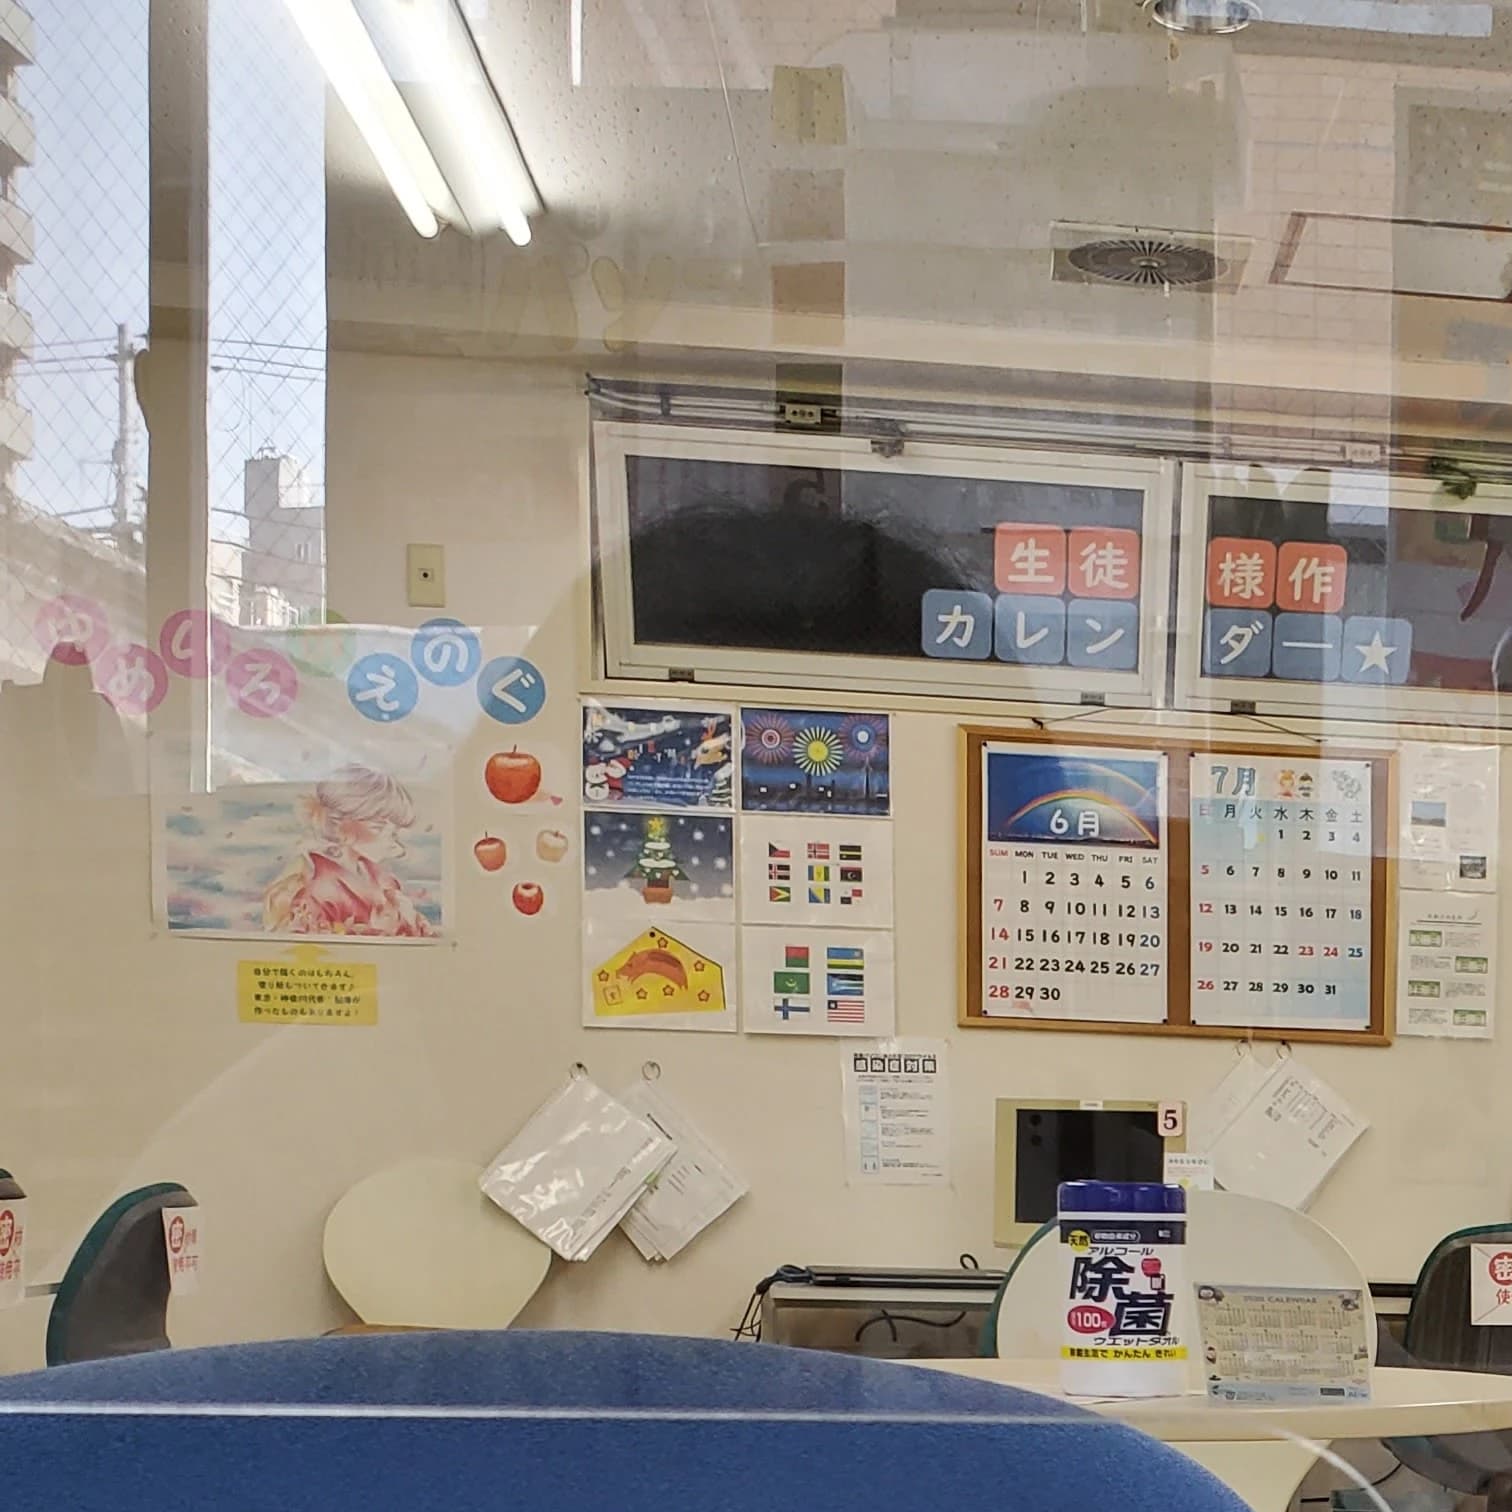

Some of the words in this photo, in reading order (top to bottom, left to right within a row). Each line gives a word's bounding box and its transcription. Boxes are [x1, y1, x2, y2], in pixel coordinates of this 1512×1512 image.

[1008, 537, 1335, 604] 生徒様作
[355, 633, 537, 721] えのぐ
[1210, 765, 1257, 796] 7月
[1050, 809, 1100, 837] 6月
[1224, 804, 1236, 819] 月
[1250, 807, 1262, 819] 火
[1274, 807, 1288, 820] 水
[1300, 808, 1314, 821] 木
[1325, 808, 1338, 822] 金
[1351, 811, 1362, 823] 土
[1278, 830, 1284, 840] 1
[1303, 830, 1311, 841] 2
[1328, 832, 1335, 842] 3
[1352, 832, 1360, 843] 4
[1022, 870, 1027, 884] 1
[1046, 872, 1055, 885] 2
[1070, 873, 1080, 886] 3
[1094, 874, 1104, 887] 4
[1121, 876, 1130, 888] 5
[1146, 876, 1154, 890] 6
[1201, 865, 1209, 875] 5
[1226, 866, 1234, 876] 6
[1252, 867, 1260, 877] 7
[1277, 867, 1285, 878] 8
[1303, 868, 1310, 879] 9
[1325, 870, 1337, 880] 10
[1352, 871, 1361, 881] 11
[994, 899, 1003, 912] 7
[1020, 900, 1029, 913] 8
[1045, 901, 1054, 914] 9
[1066, 902, 1085, 916] 10
[1092, 904, 1107, 916] 11
[1118, 904, 1136, 918] 12
[1142, 906, 1160, 919] 13
[1199, 903, 1212, 913] 12
[1225, 905, 1237, 914] 13
[1250, 905, 1262, 915] 14
[1275, 906, 1287, 917] 15
[1300, 907, 1313, 918] 16
[1326, 909, 1336, 919] 17
[1350, 909, 1362, 920] 18
[992, 928, 1010, 940] 14
[1017, 928, 1034, 942] 15
[1042, 930, 1060, 943] 16
[1067, 930, 1085, 944] 17
[1092, 932, 1110, 946] 18
[1118, 934, 1136, 947] 19
[1140, 934, 1160, 948] 20
[1199, 942, 1212, 952] 19
[1222, 943, 1239, 953] 20
[1250, 944, 1262, 953] 21
[1273, 944, 1289, 955] 22
[1299, 946, 1314, 956] 23
[1323, 947, 1338, 957] 24
[1348, 948, 1362, 958] 25
[988, 957, 1006, 970] 21
[1014, 958, 1034, 971] 22
[1040, 959, 1060, 972] 23
[1064, 960, 1086, 973] 24
[1090, 961, 1110, 974] 25
[1116, 962, 1136, 976] 26
[1140, 963, 1160, 976] 27
[988, 985, 1009, 998] 28
[1014, 986, 1034, 1000] 29
[1040, 987, 1060, 1000] 30
[1197, 980, 1214, 991] 26
[1224, 981, 1238, 991] 27
[1248, 982, 1263, 993] 28
[1273, 983, 1288, 993] 29
[1297, 984, 1314, 994] 30
[1325, 985, 1336, 995] 31
[1164, 1110, 1178, 1130] 5
[1088, 1246, 1154, 1255] アルコール
[1094, 1337, 1179, 1346] ウエットタオル
[1114, 1347, 1150, 1358] かんたん
